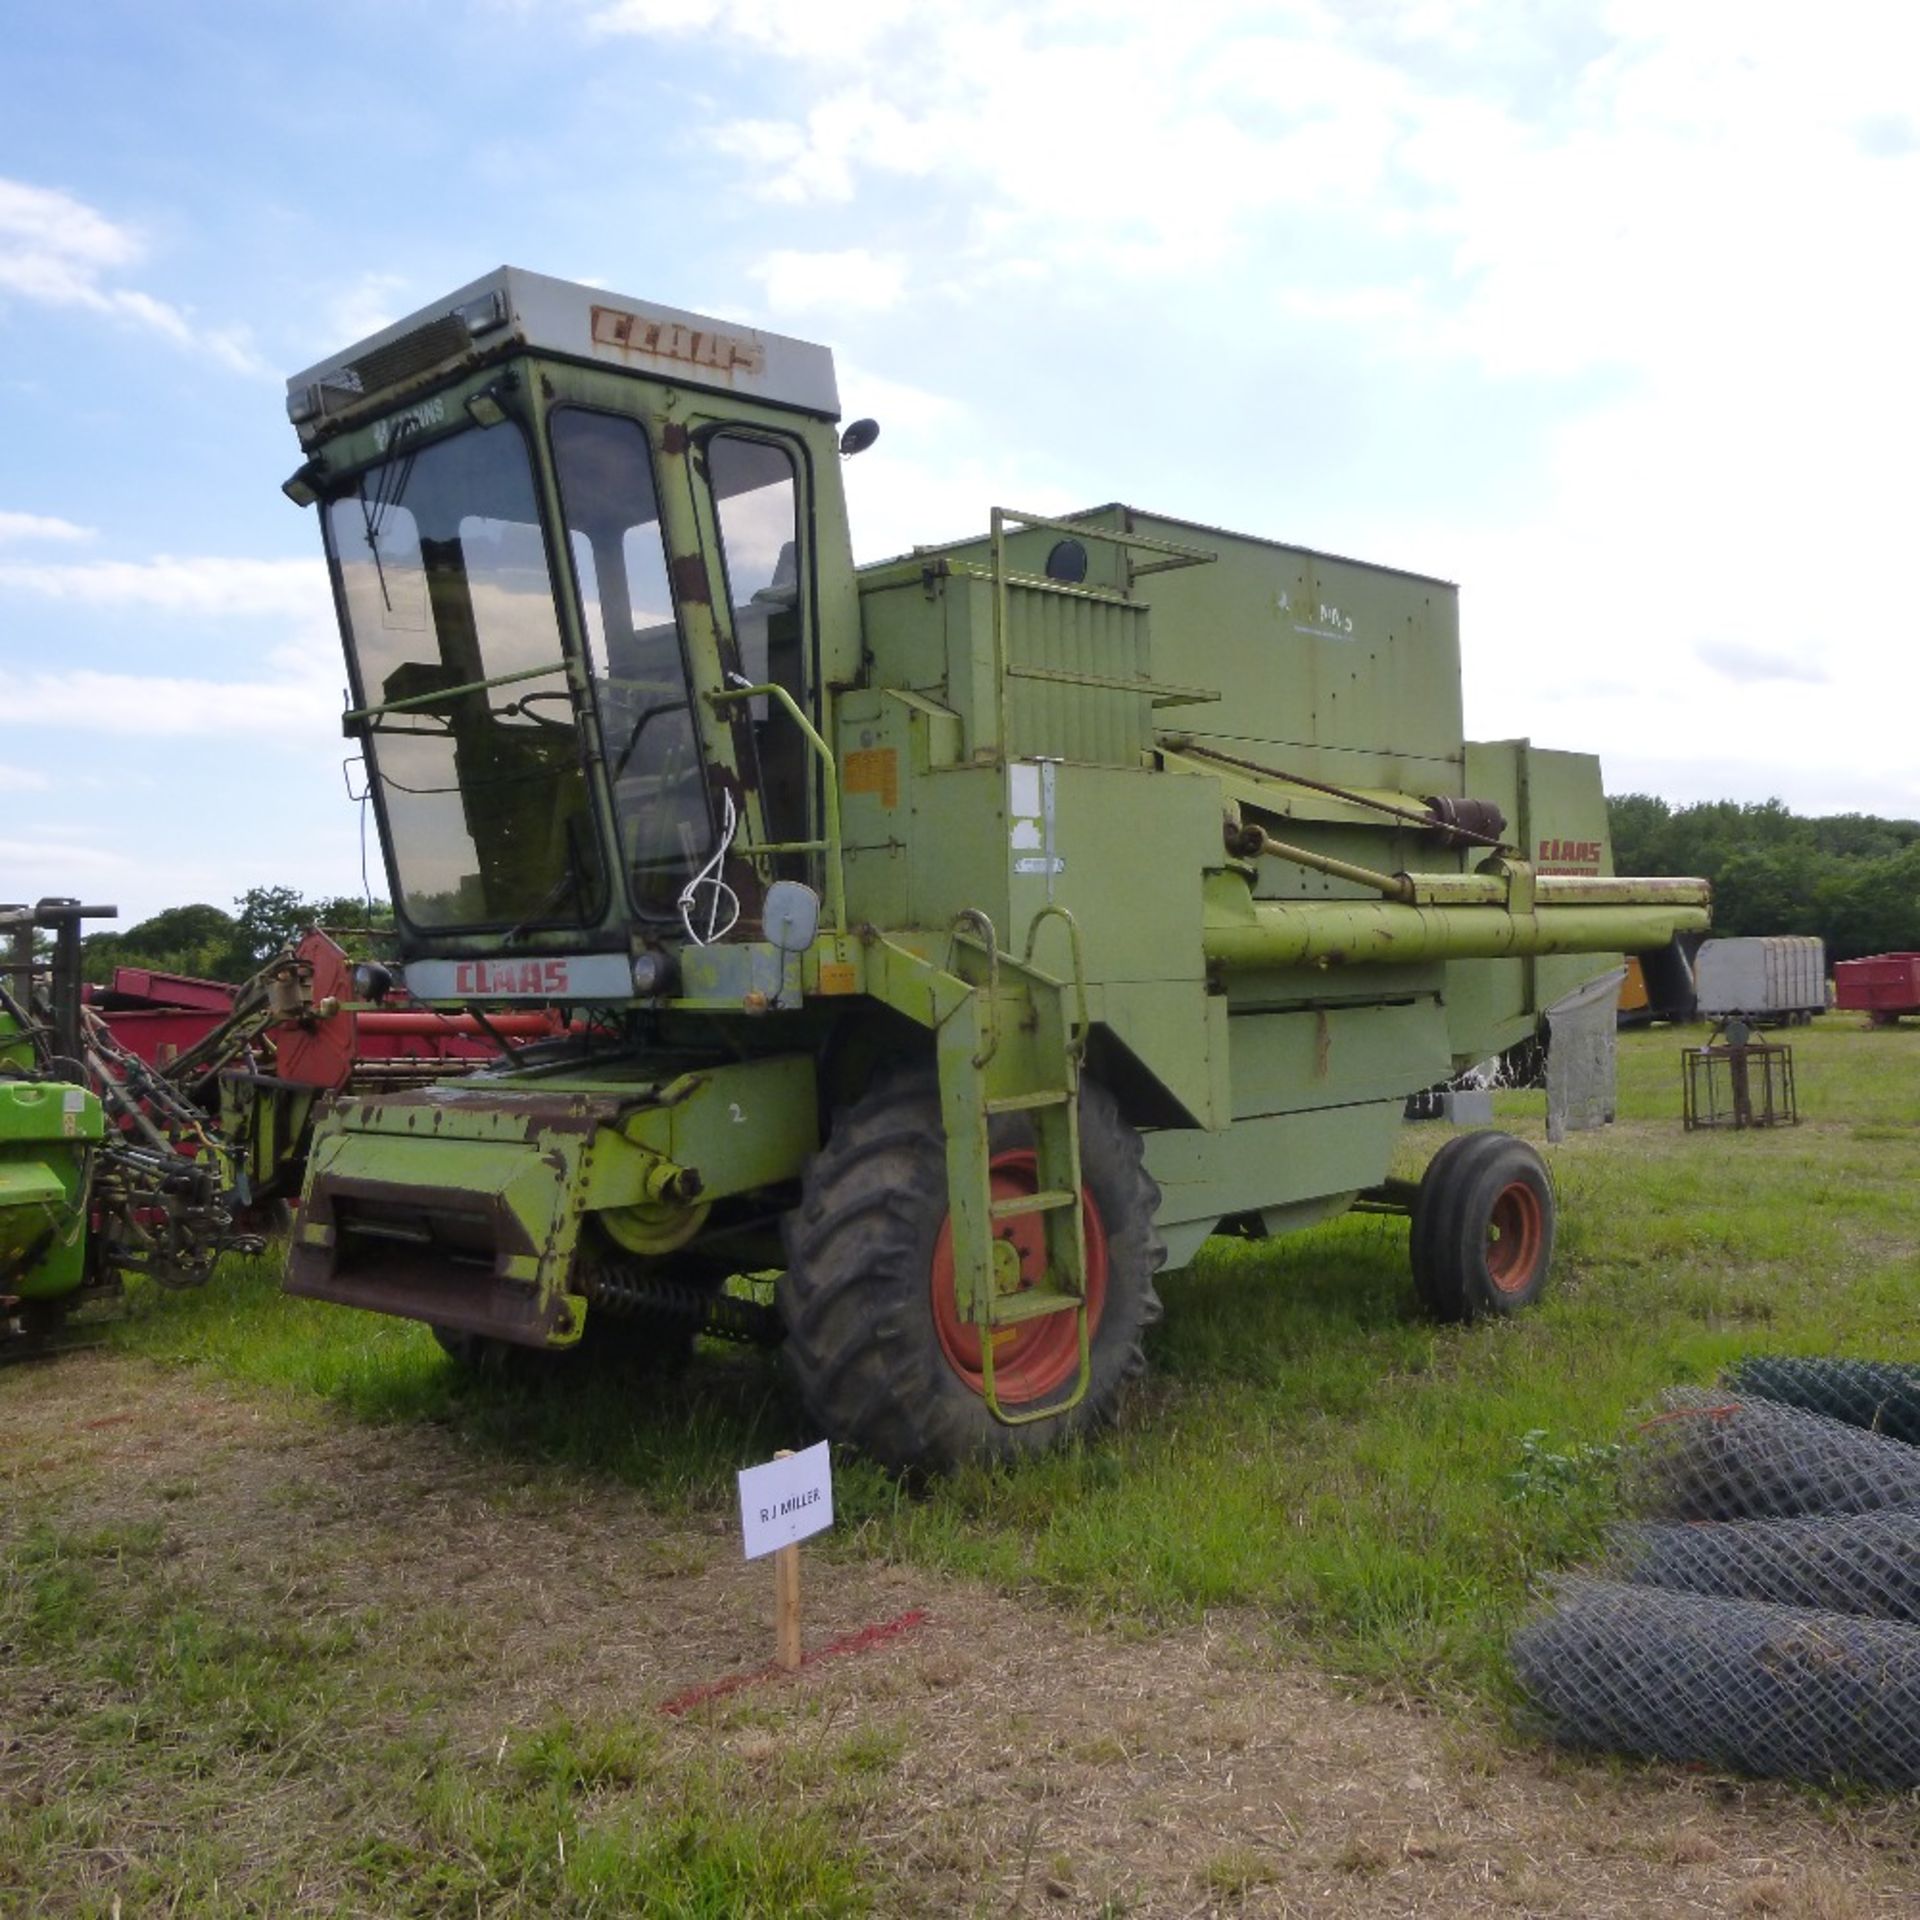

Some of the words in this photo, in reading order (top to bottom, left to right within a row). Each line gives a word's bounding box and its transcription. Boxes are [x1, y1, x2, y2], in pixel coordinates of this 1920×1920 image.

[1539, 839, 1601, 862] CLAAS
[456, 961, 568, 993] CLAAS
[729, 1103, 747, 1122] 2
[760, 1508, 769, 1523] R
[772, 1504, 777, 1520] J
[780, 1487, 821, 1516] MILLER
